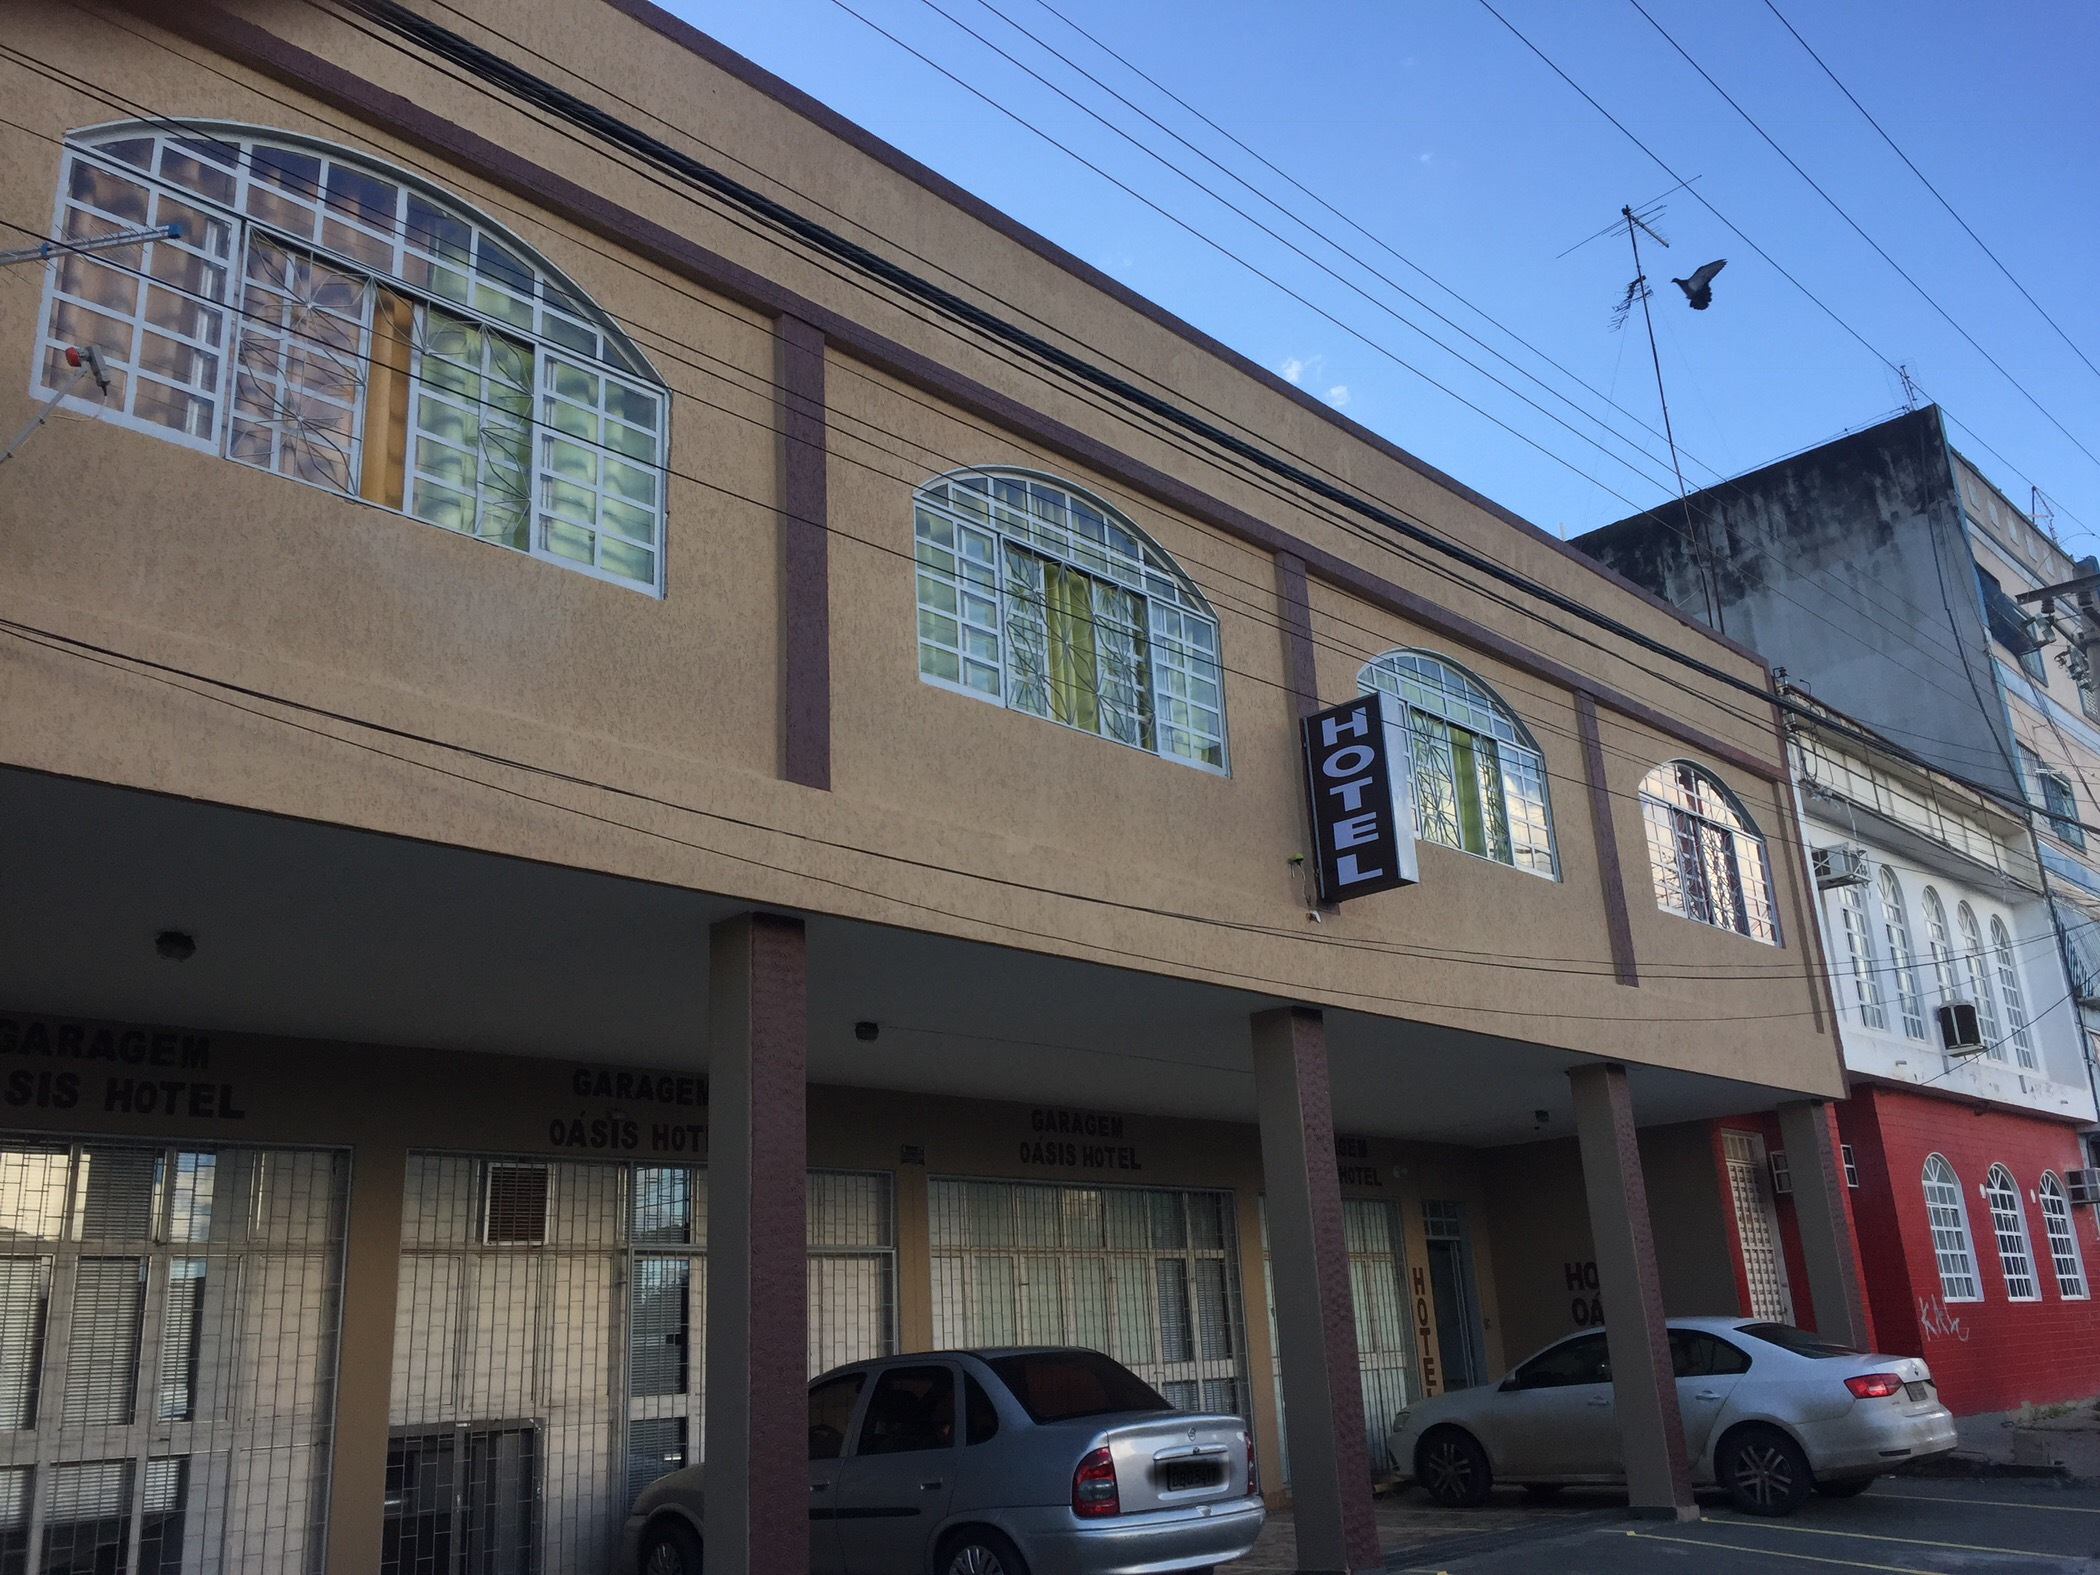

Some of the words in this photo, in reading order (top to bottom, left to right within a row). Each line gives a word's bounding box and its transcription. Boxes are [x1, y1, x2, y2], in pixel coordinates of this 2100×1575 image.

[1320, 706, 1384, 887] HOTEL
[103, 1077, 246, 1120] HOTEL
[549, 1109, 639, 1150] OÁSIS
[652, 1123, 709, 1153] HOT
[1031, 1109, 1124, 1139] GARAGEM
[1018, 1136, 1077, 1167] OÁSIS
[1082, 1146, 1142, 1171] HOTEL
[1338, 1165, 1383, 1187] HOTEL
